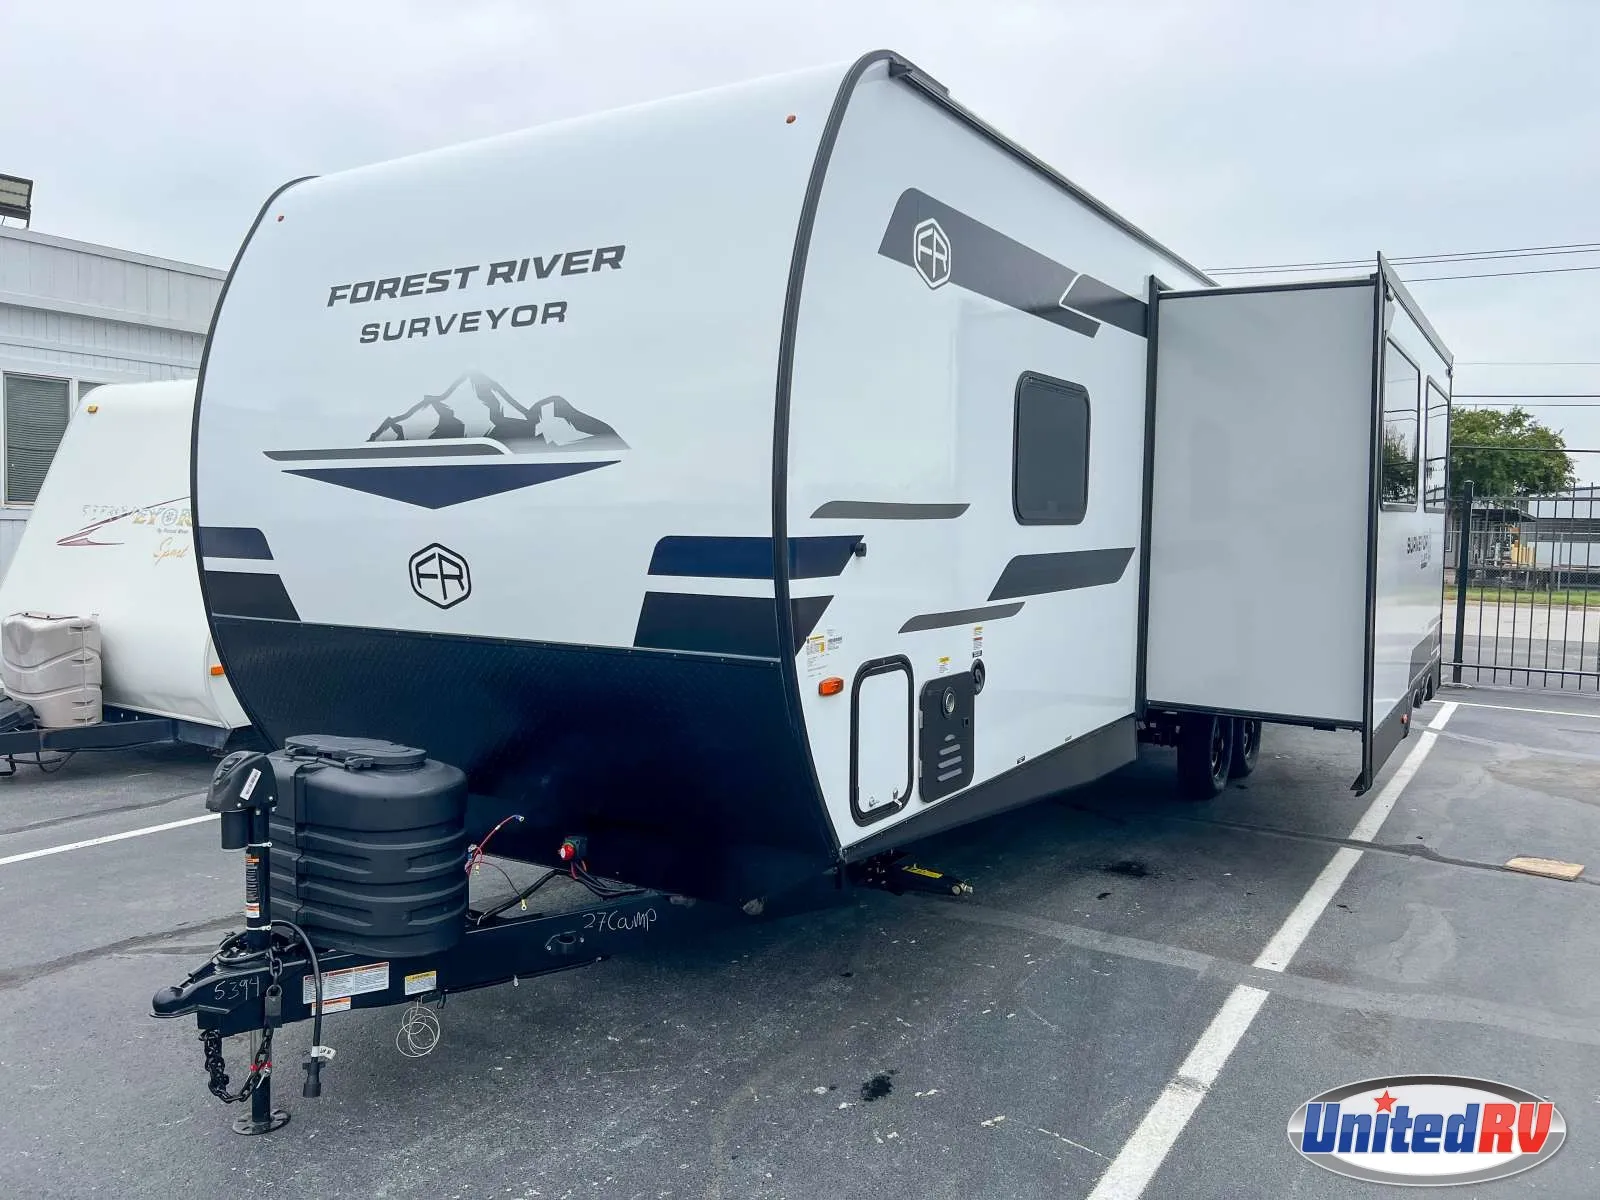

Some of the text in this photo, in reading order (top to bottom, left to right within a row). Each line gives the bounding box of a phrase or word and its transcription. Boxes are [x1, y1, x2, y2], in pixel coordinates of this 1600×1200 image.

[327, 245, 626, 307] FOREST RIVER
[360, 301, 567, 343] SURVEYOR
